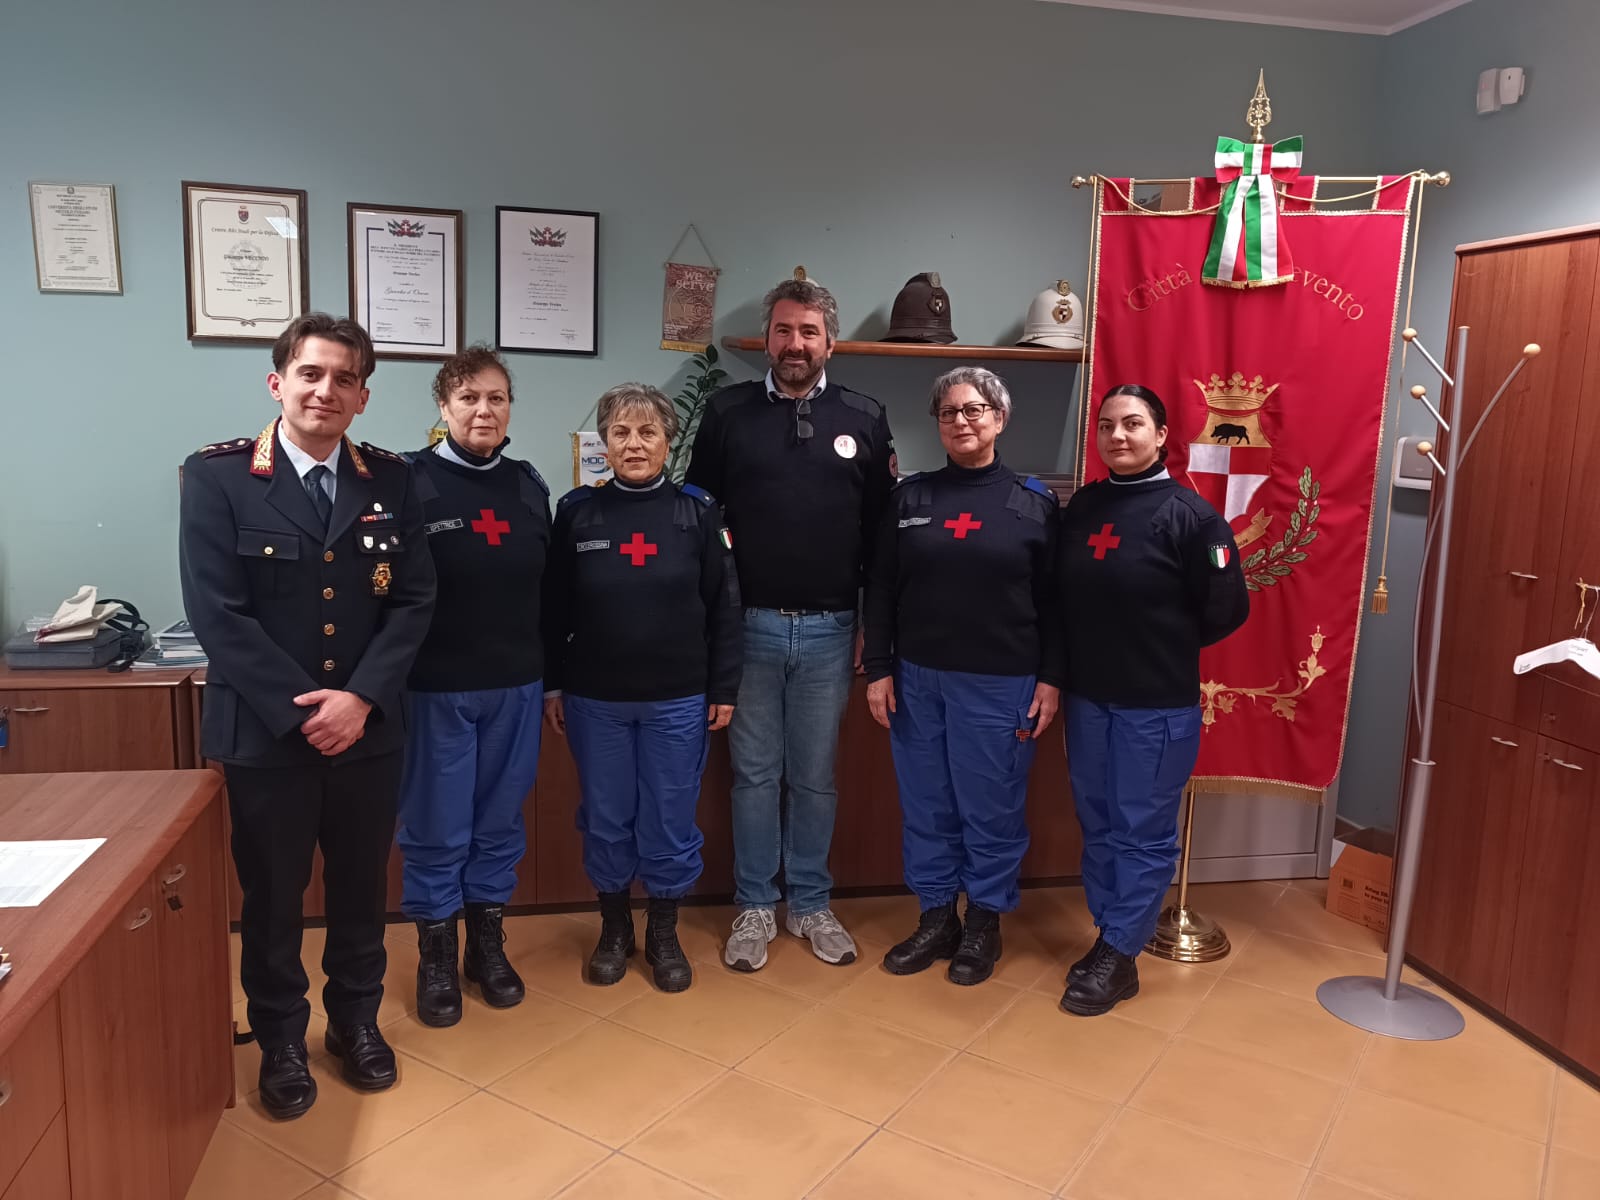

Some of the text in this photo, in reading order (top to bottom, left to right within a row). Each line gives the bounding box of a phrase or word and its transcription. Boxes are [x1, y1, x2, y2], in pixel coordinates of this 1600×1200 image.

[675, 279, 714, 292] serve
[685, 271, 703, 282] we
[1128, 263, 1193, 312] Città
[1294, 266, 1364, 320] evento
